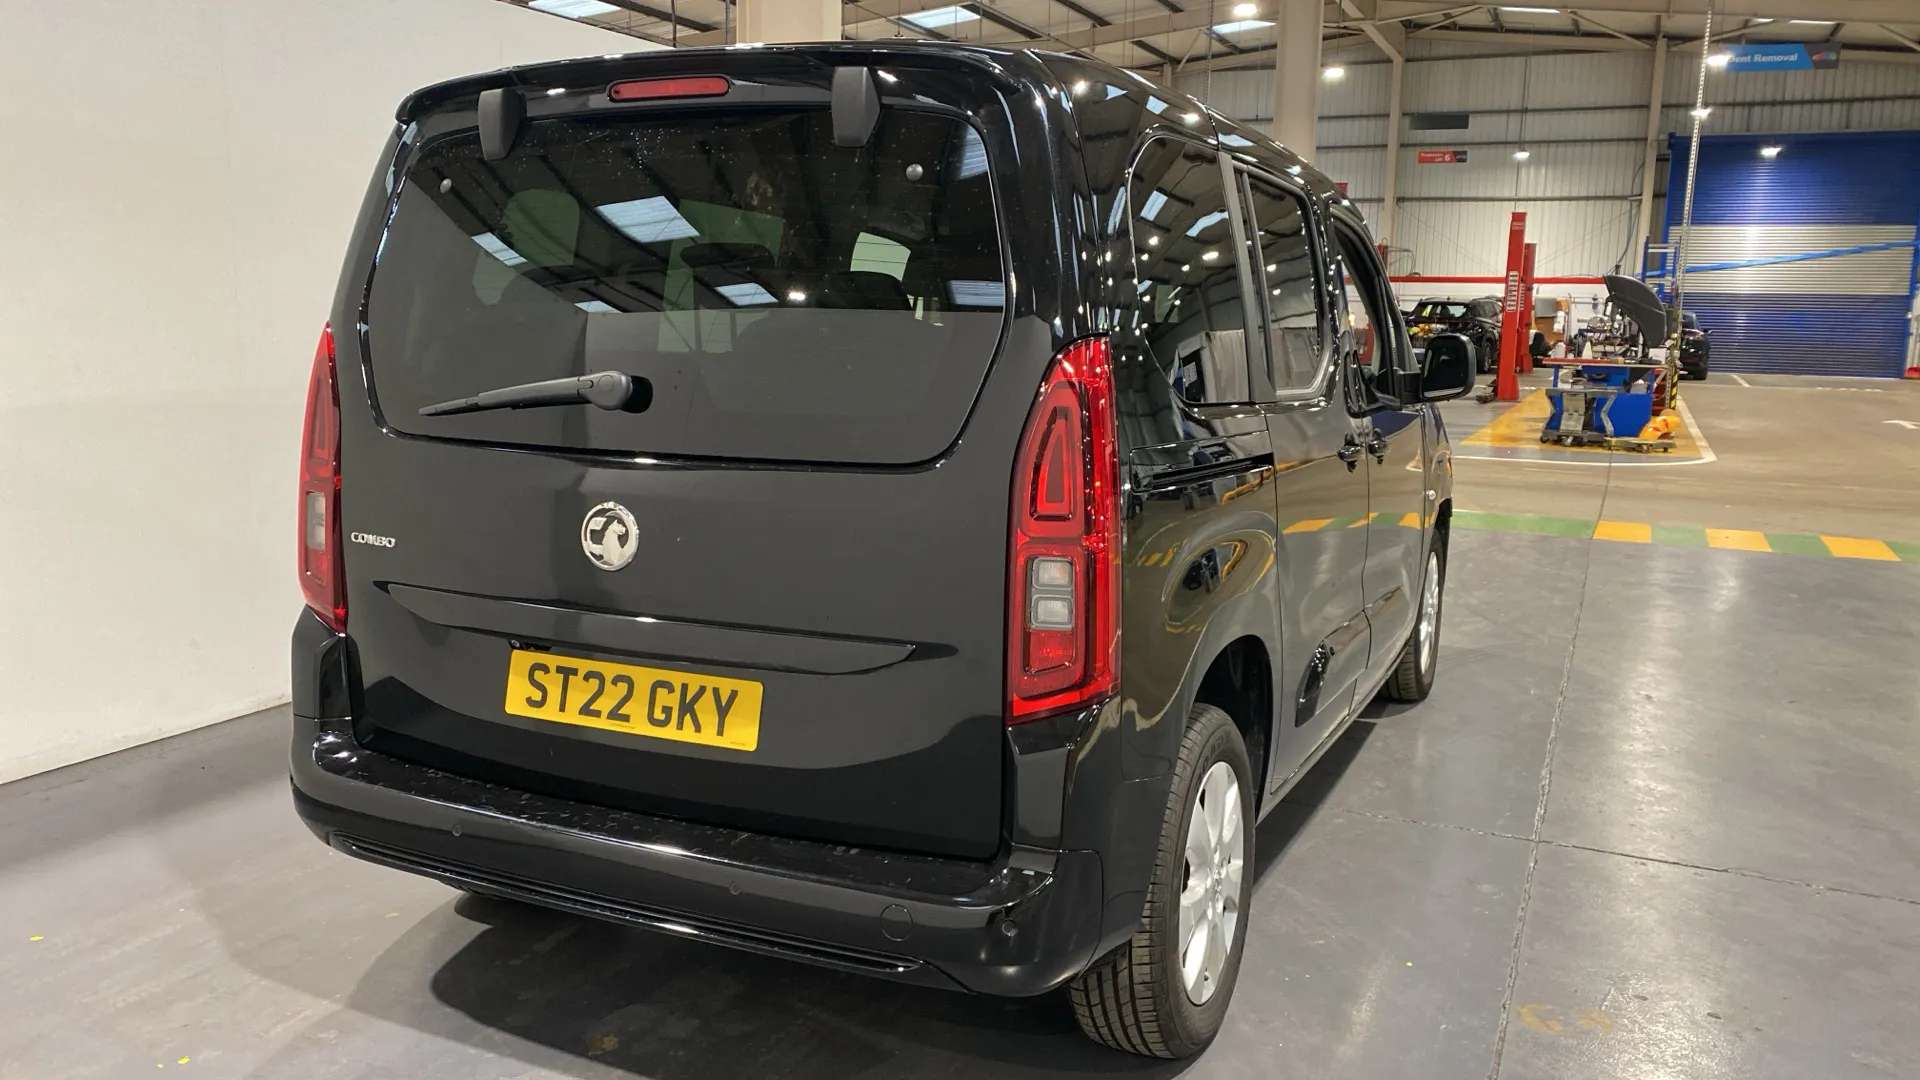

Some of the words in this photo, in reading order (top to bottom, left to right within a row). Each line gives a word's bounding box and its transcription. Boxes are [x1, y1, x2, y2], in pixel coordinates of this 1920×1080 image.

[1753, 53, 1798, 62] Removal
[525, 662, 635, 723] ST22
[646, 679, 739, 737] GKY
